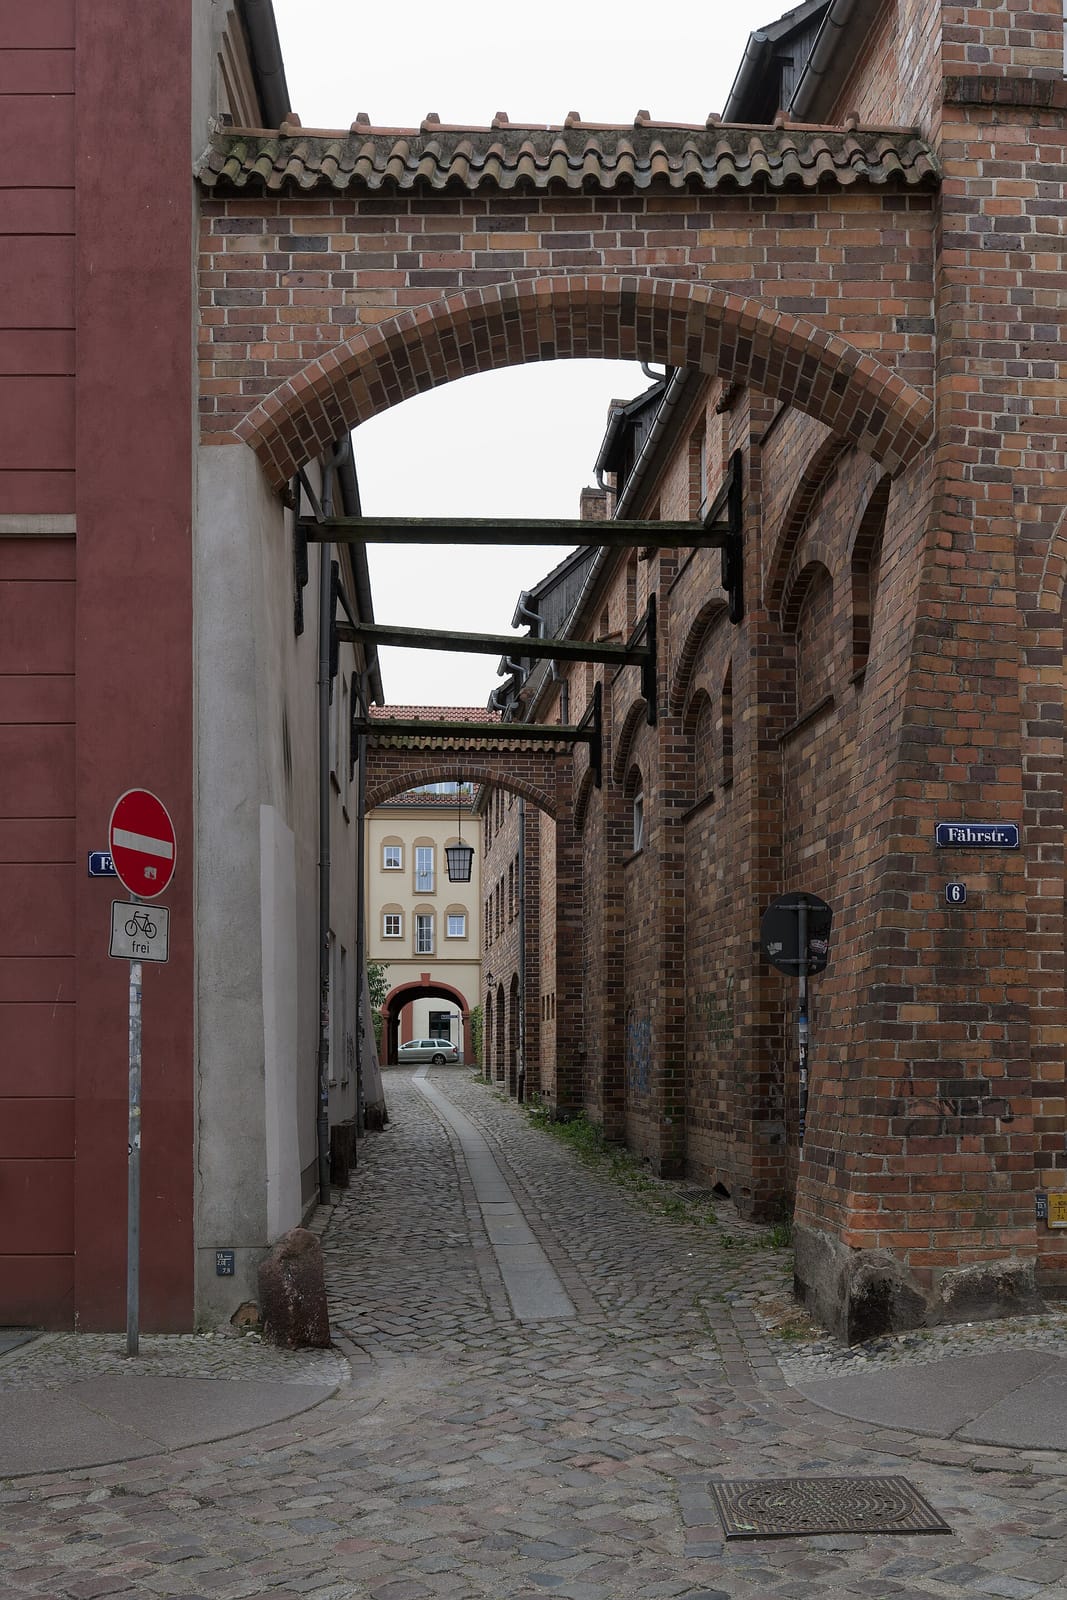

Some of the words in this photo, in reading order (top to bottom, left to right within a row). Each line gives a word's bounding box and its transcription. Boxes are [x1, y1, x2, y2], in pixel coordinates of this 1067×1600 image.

[948, 827, 1009, 842] Fährstr.
[951, 885, 961, 901] 6
[132, 940, 150, 954] frei
